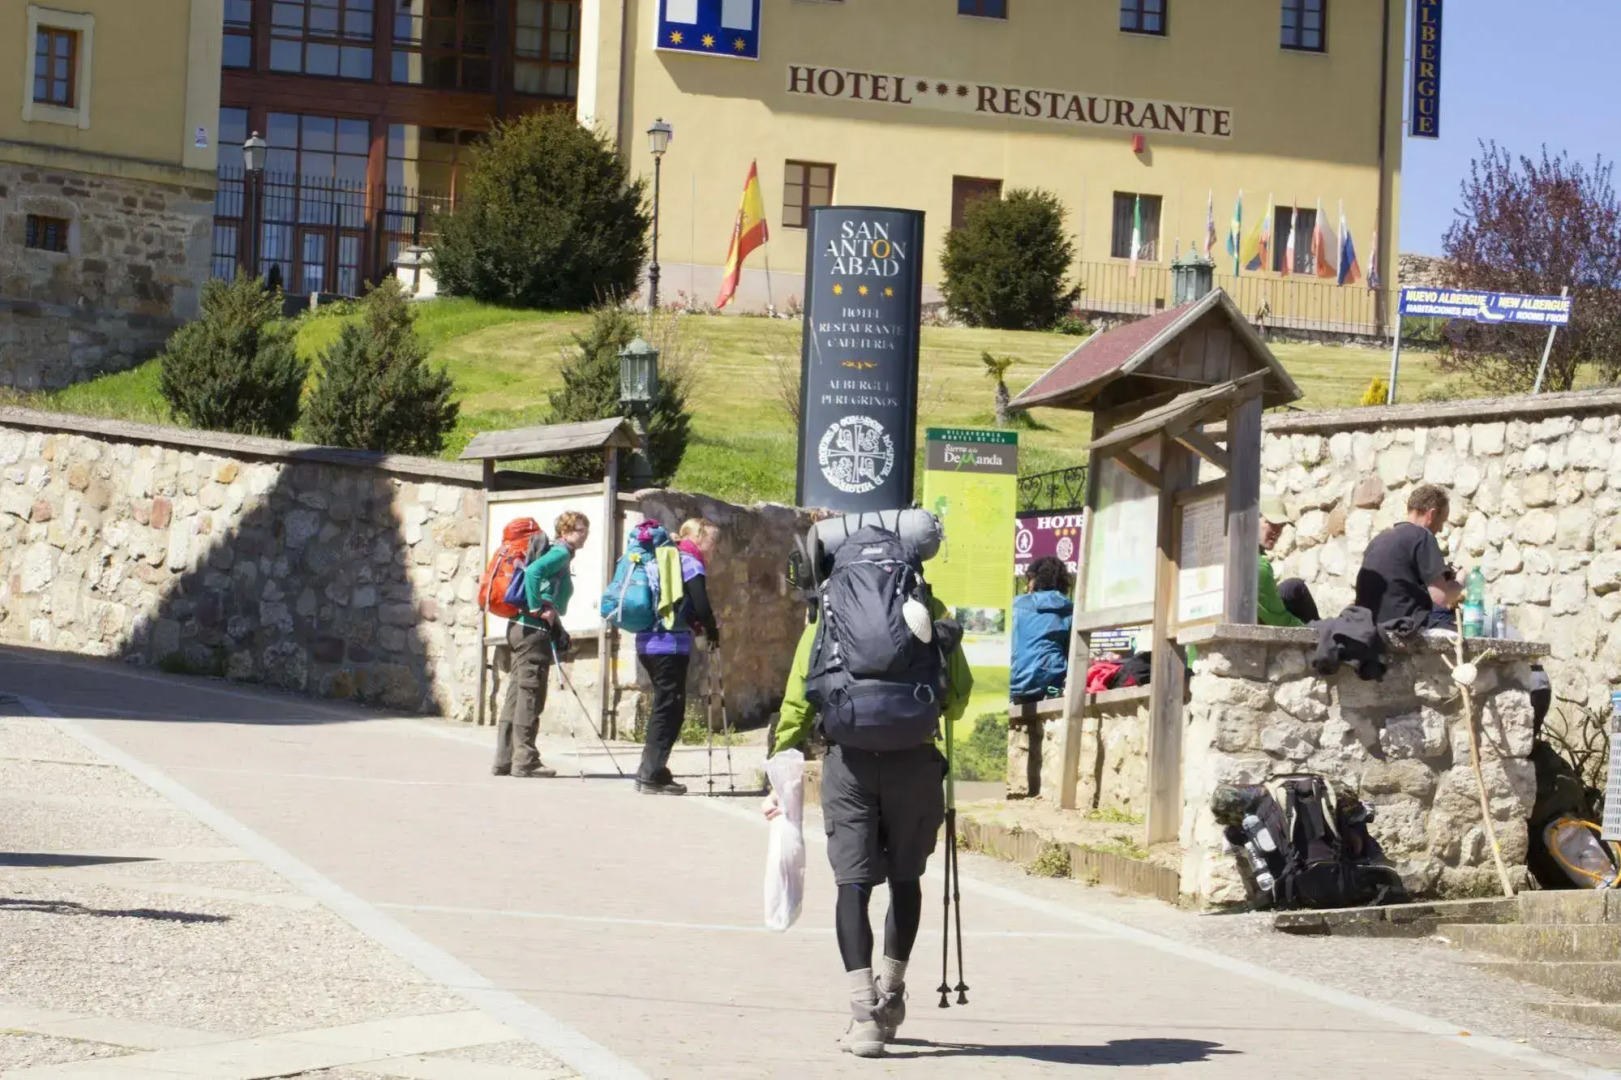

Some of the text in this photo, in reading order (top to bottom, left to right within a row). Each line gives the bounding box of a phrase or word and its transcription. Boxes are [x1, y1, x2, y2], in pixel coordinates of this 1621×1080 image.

[1418, 0, 1436, 133] LBERGUE
[787, 66, 1231, 136] HOTEL RESTAURANTE
[841, 220, 889, 240] SAN
[824, 239, 906, 259] ANTON
[830, 257, 899, 277] ABAD
[1405, 290, 1438, 303] NUEVO
[1438, 292, 1488, 306] ALBERGUE
[1498, 297, 1521, 309] NEW
[1521, 298, 1571, 312] ALBERGUE
[842, 307, 879, 318] HOTEL
[819, 322, 905, 336] RESTAURANTE
[829, 380, 891, 391] ALBERGUE
[821, 394, 898, 406] PEREGRINOS
[1037, 514, 1084, 530] HOTE
